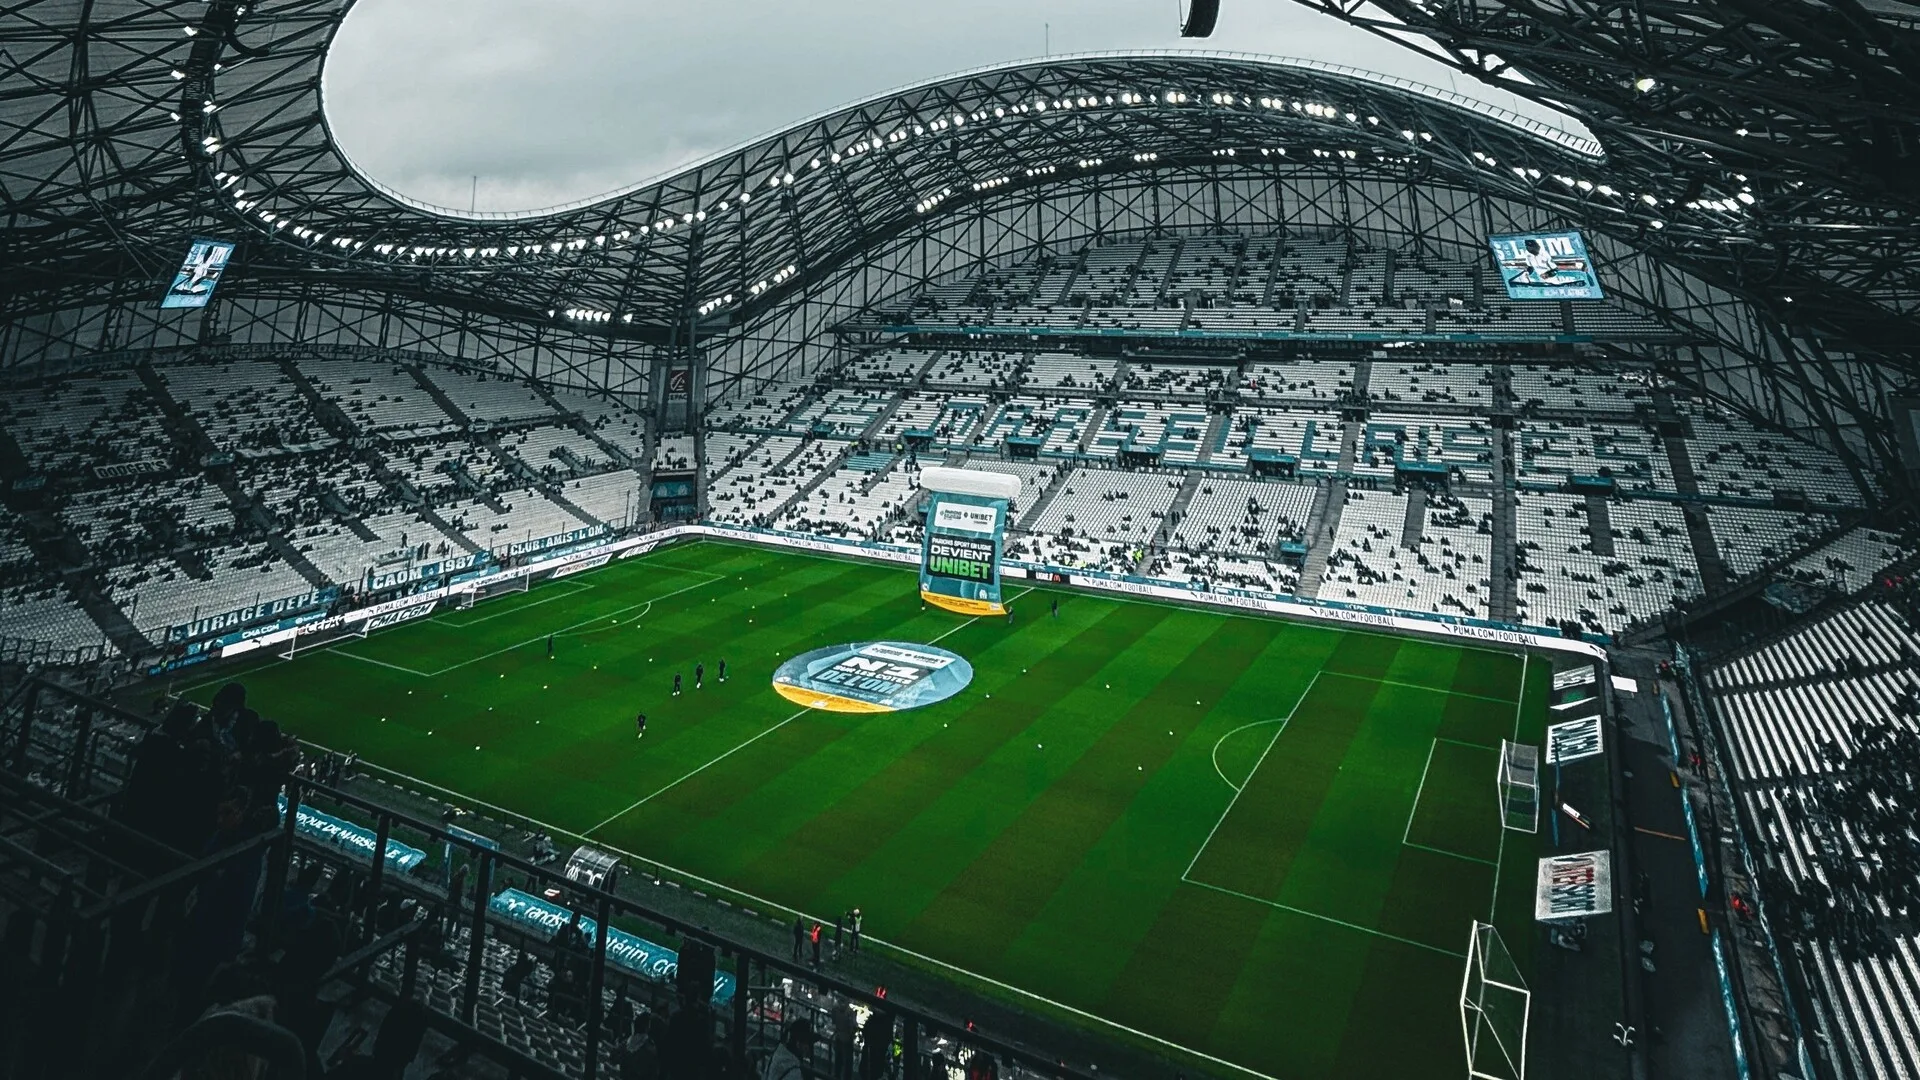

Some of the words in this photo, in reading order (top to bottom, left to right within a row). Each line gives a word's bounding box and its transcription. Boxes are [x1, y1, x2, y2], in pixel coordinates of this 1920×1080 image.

[96, 459, 168, 478] DODGER'S
[969, 512, 993, 522] UNIBET
[510, 539, 540, 557] CLUB
[545, 533, 574, 549] AMIS
[931, 537, 953, 547] PARIONS
[953, 538, 971, 549] SPORT
[930, 545, 992, 561] DEVIENT
[372, 566, 423, 590] CAOM
[438, 554, 476, 574] 1987
[929, 556, 991, 580] UNIBET
[1091, 579, 1153, 594] PUMA.COM/FOOTBALL
[1199, 593, 1268, 610] PUMA.COM/FOOTBALL
[186, 604, 266, 637] VIRAGE
[368, 612, 399, 630] CMA
[398, 602, 430, 621] CGM
[1319, 608, 1396, 626] PUMA.COM/FOOTBALL
[241, 627, 261, 639] CMA
[261, 623, 280, 634] CGM
[1452, 625, 1538, 646] PUMA.COM/FOOTBALL
[832, 665, 855, 675] SUR
[854, 667, 877, 679] LES
[815, 669, 846, 685] DE
[845, 676, 901, 695] L'OM
